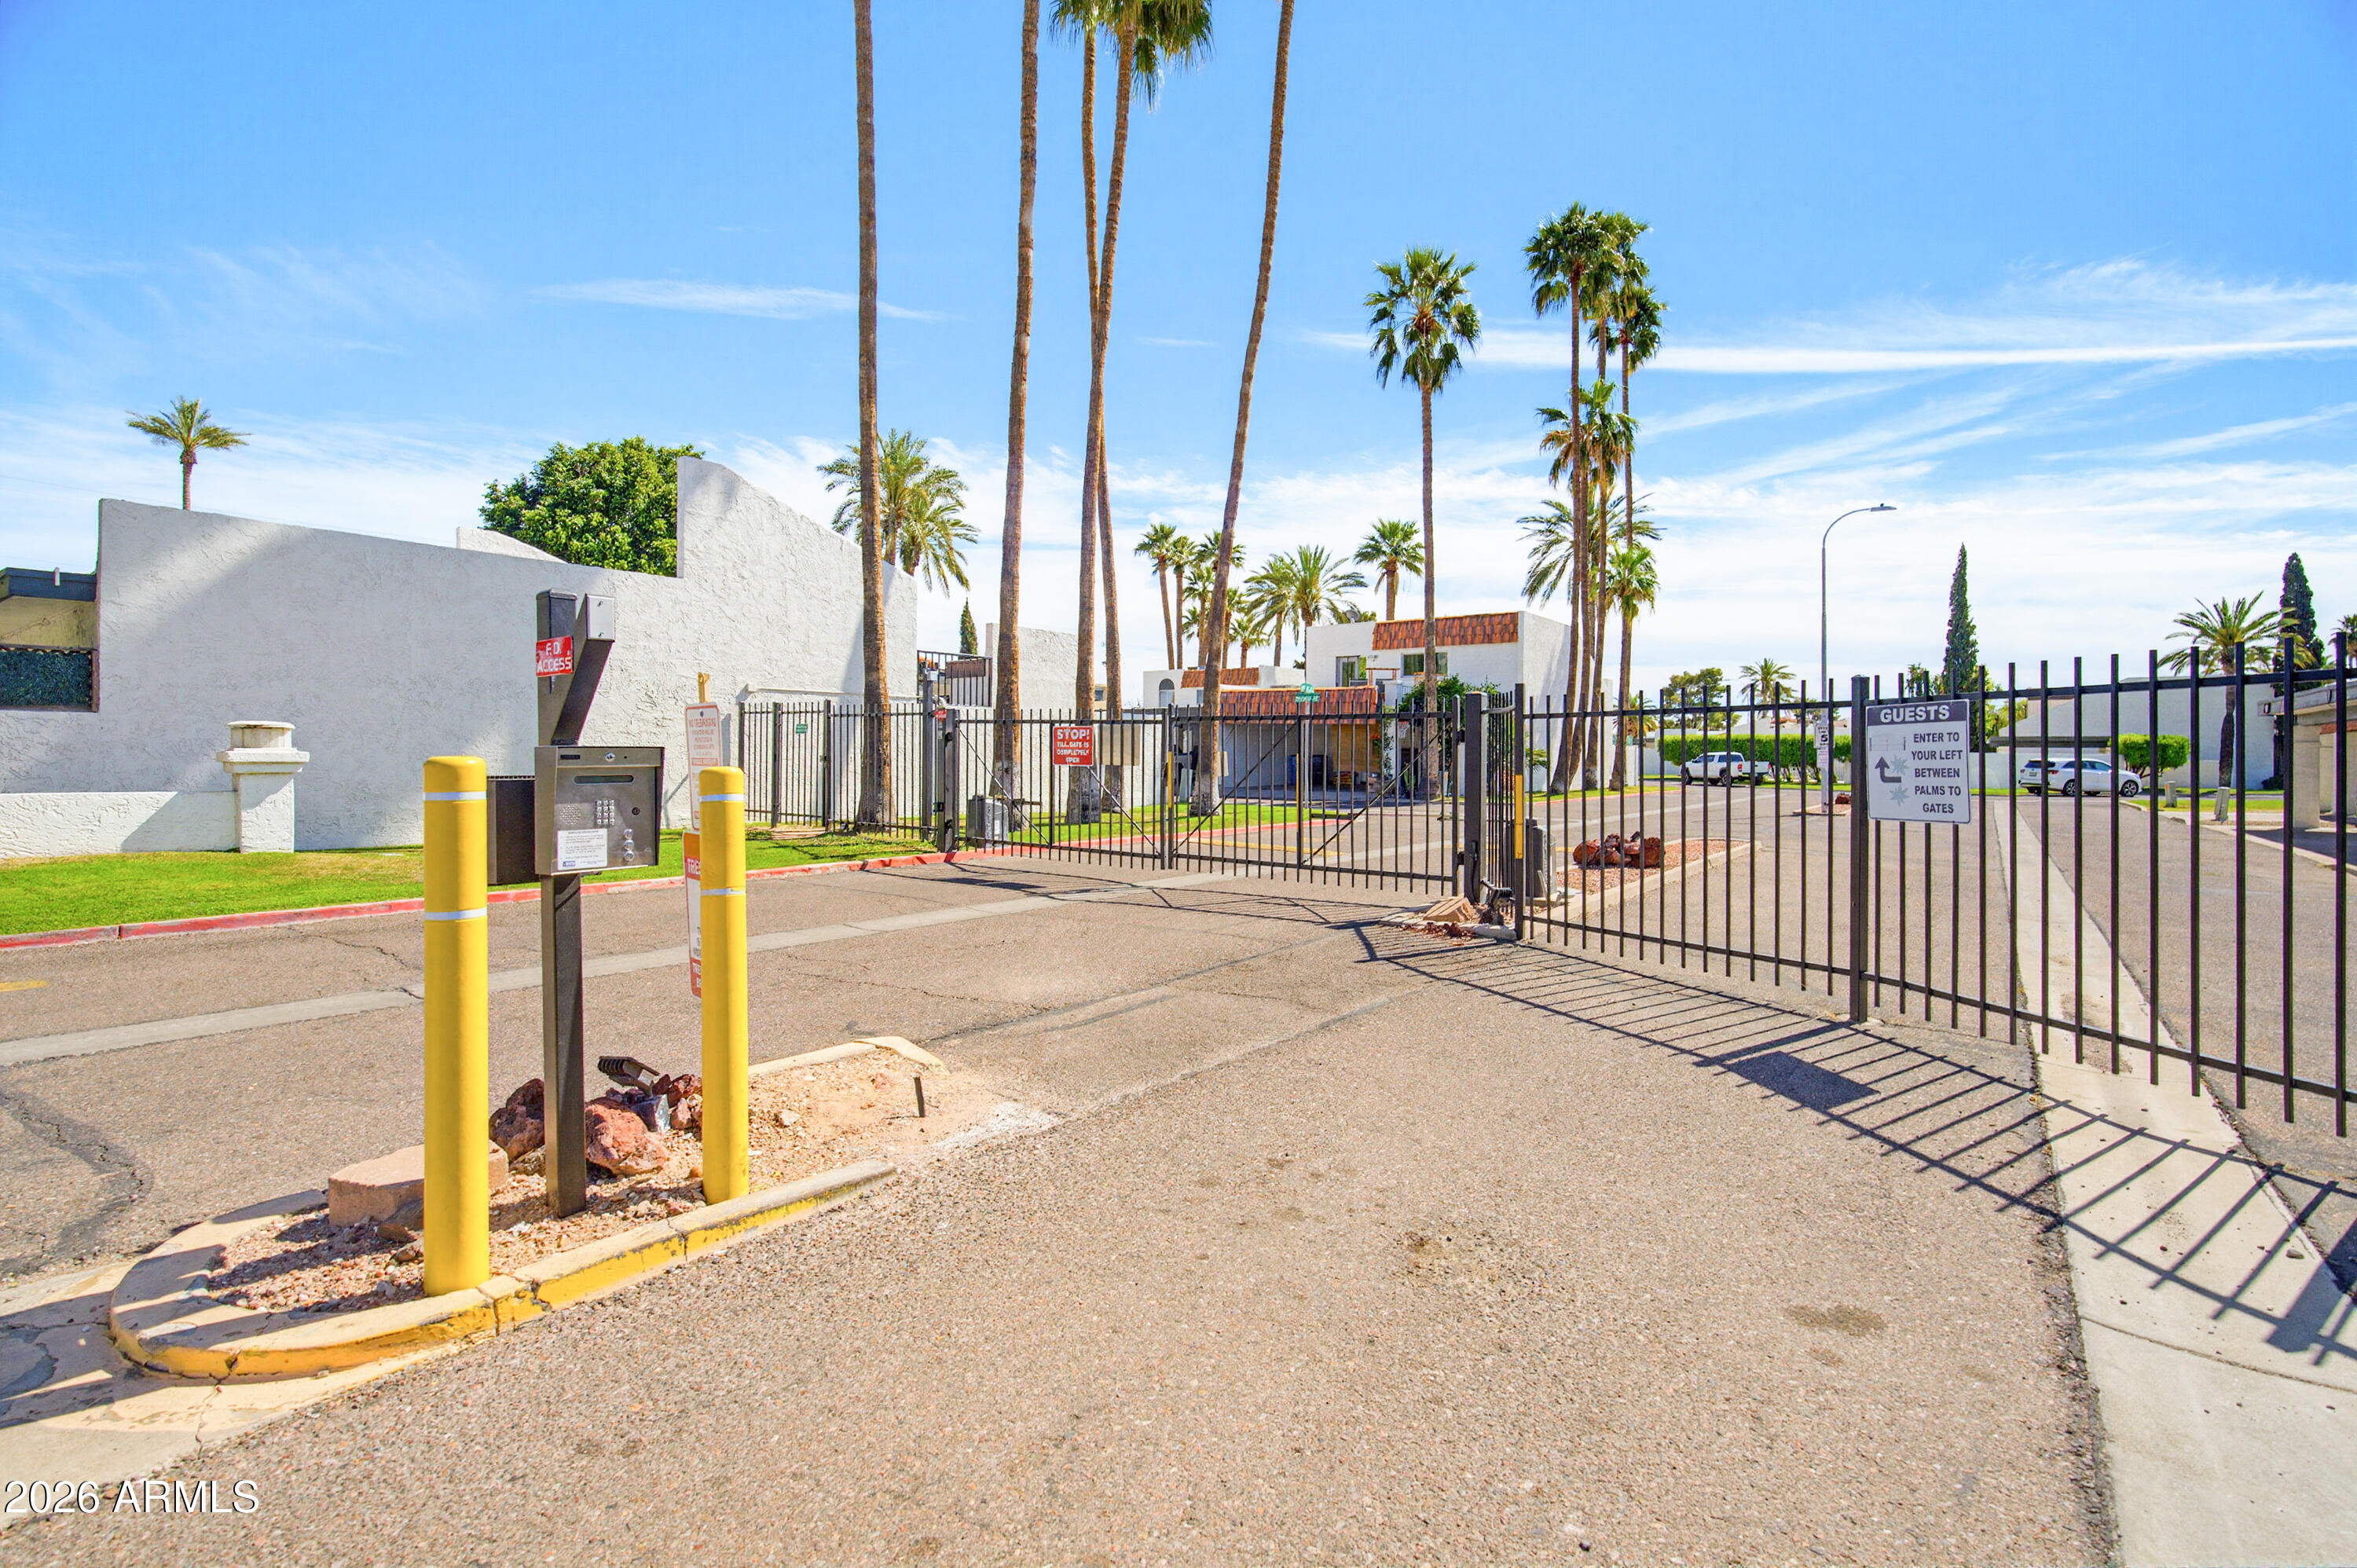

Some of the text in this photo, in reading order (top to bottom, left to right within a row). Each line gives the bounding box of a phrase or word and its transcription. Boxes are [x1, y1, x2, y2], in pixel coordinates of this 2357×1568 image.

[537, 656, 572, 673] ACCESS
[1880, 705, 1950, 723] GUESTS
[1057, 728, 1090, 740] STOP!
[1913, 731, 1960, 743] ENTER TO
[1912, 749, 1963, 760] YOUR LEFT
[1915, 768, 1960, 778] BETWEEN
[1915, 786, 1961, 796] PALMS TO
[1923, 803, 1954, 813] GATES
